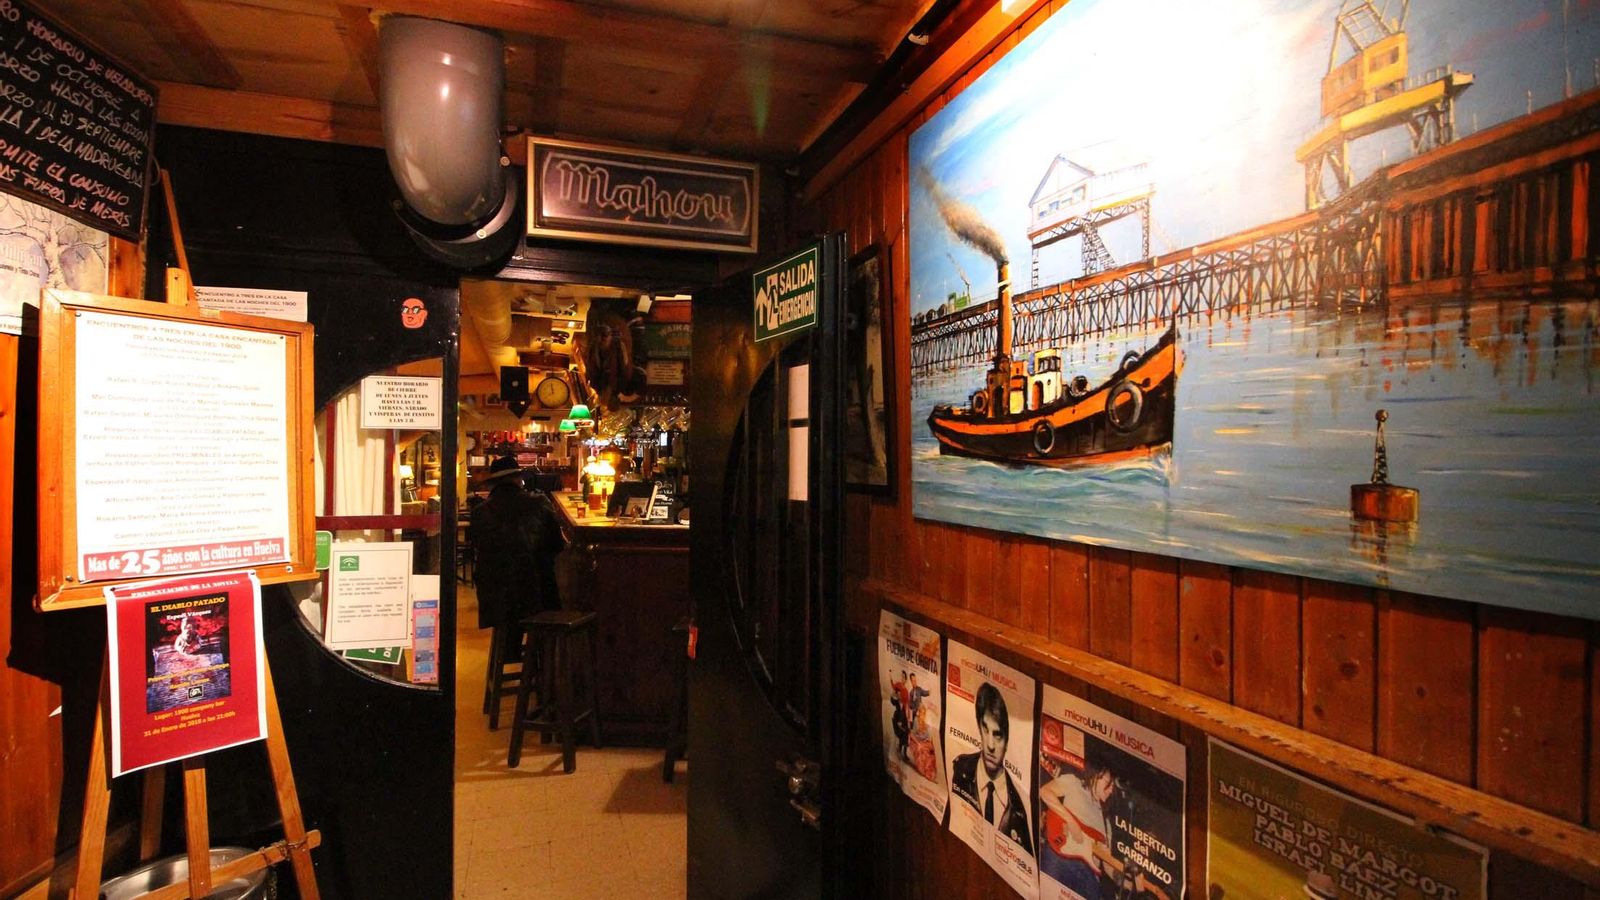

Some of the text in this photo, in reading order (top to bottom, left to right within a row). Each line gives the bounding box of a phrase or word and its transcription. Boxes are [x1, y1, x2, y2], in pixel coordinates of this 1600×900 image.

[556, 159, 735, 222] Mahou
[780, 259, 815, 296] SALIDA
[779, 289, 815, 325] EMERGENCIA
[108, 555, 121, 570] de
[121, 549, 161, 574] 25
[161, 548, 183, 565] años
[184, 549, 201, 562] con
[201, 545, 211, 561] la
[211, 545, 242, 559] cultura
[243, 545, 254, 557] en
[254, 541, 281, 556] Huelva
[150, 596, 226, 614] EL DIABLO PATADO
[906, 648, 915, 664] DE
[949, 726, 983, 750] FERNANDO
[1064, 708, 1108, 735] microUHU
[1114, 730, 1156, 760] MUSICA
[1115, 815, 1176, 861] LA LIBERTAD
[1133, 840, 1149, 857] del
[1219, 780, 1457, 900] MIGUEL DE MARGOT
[1255, 813, 1323, 858] PABLO
[1117, 841, 1172, 885] GARBANZO
